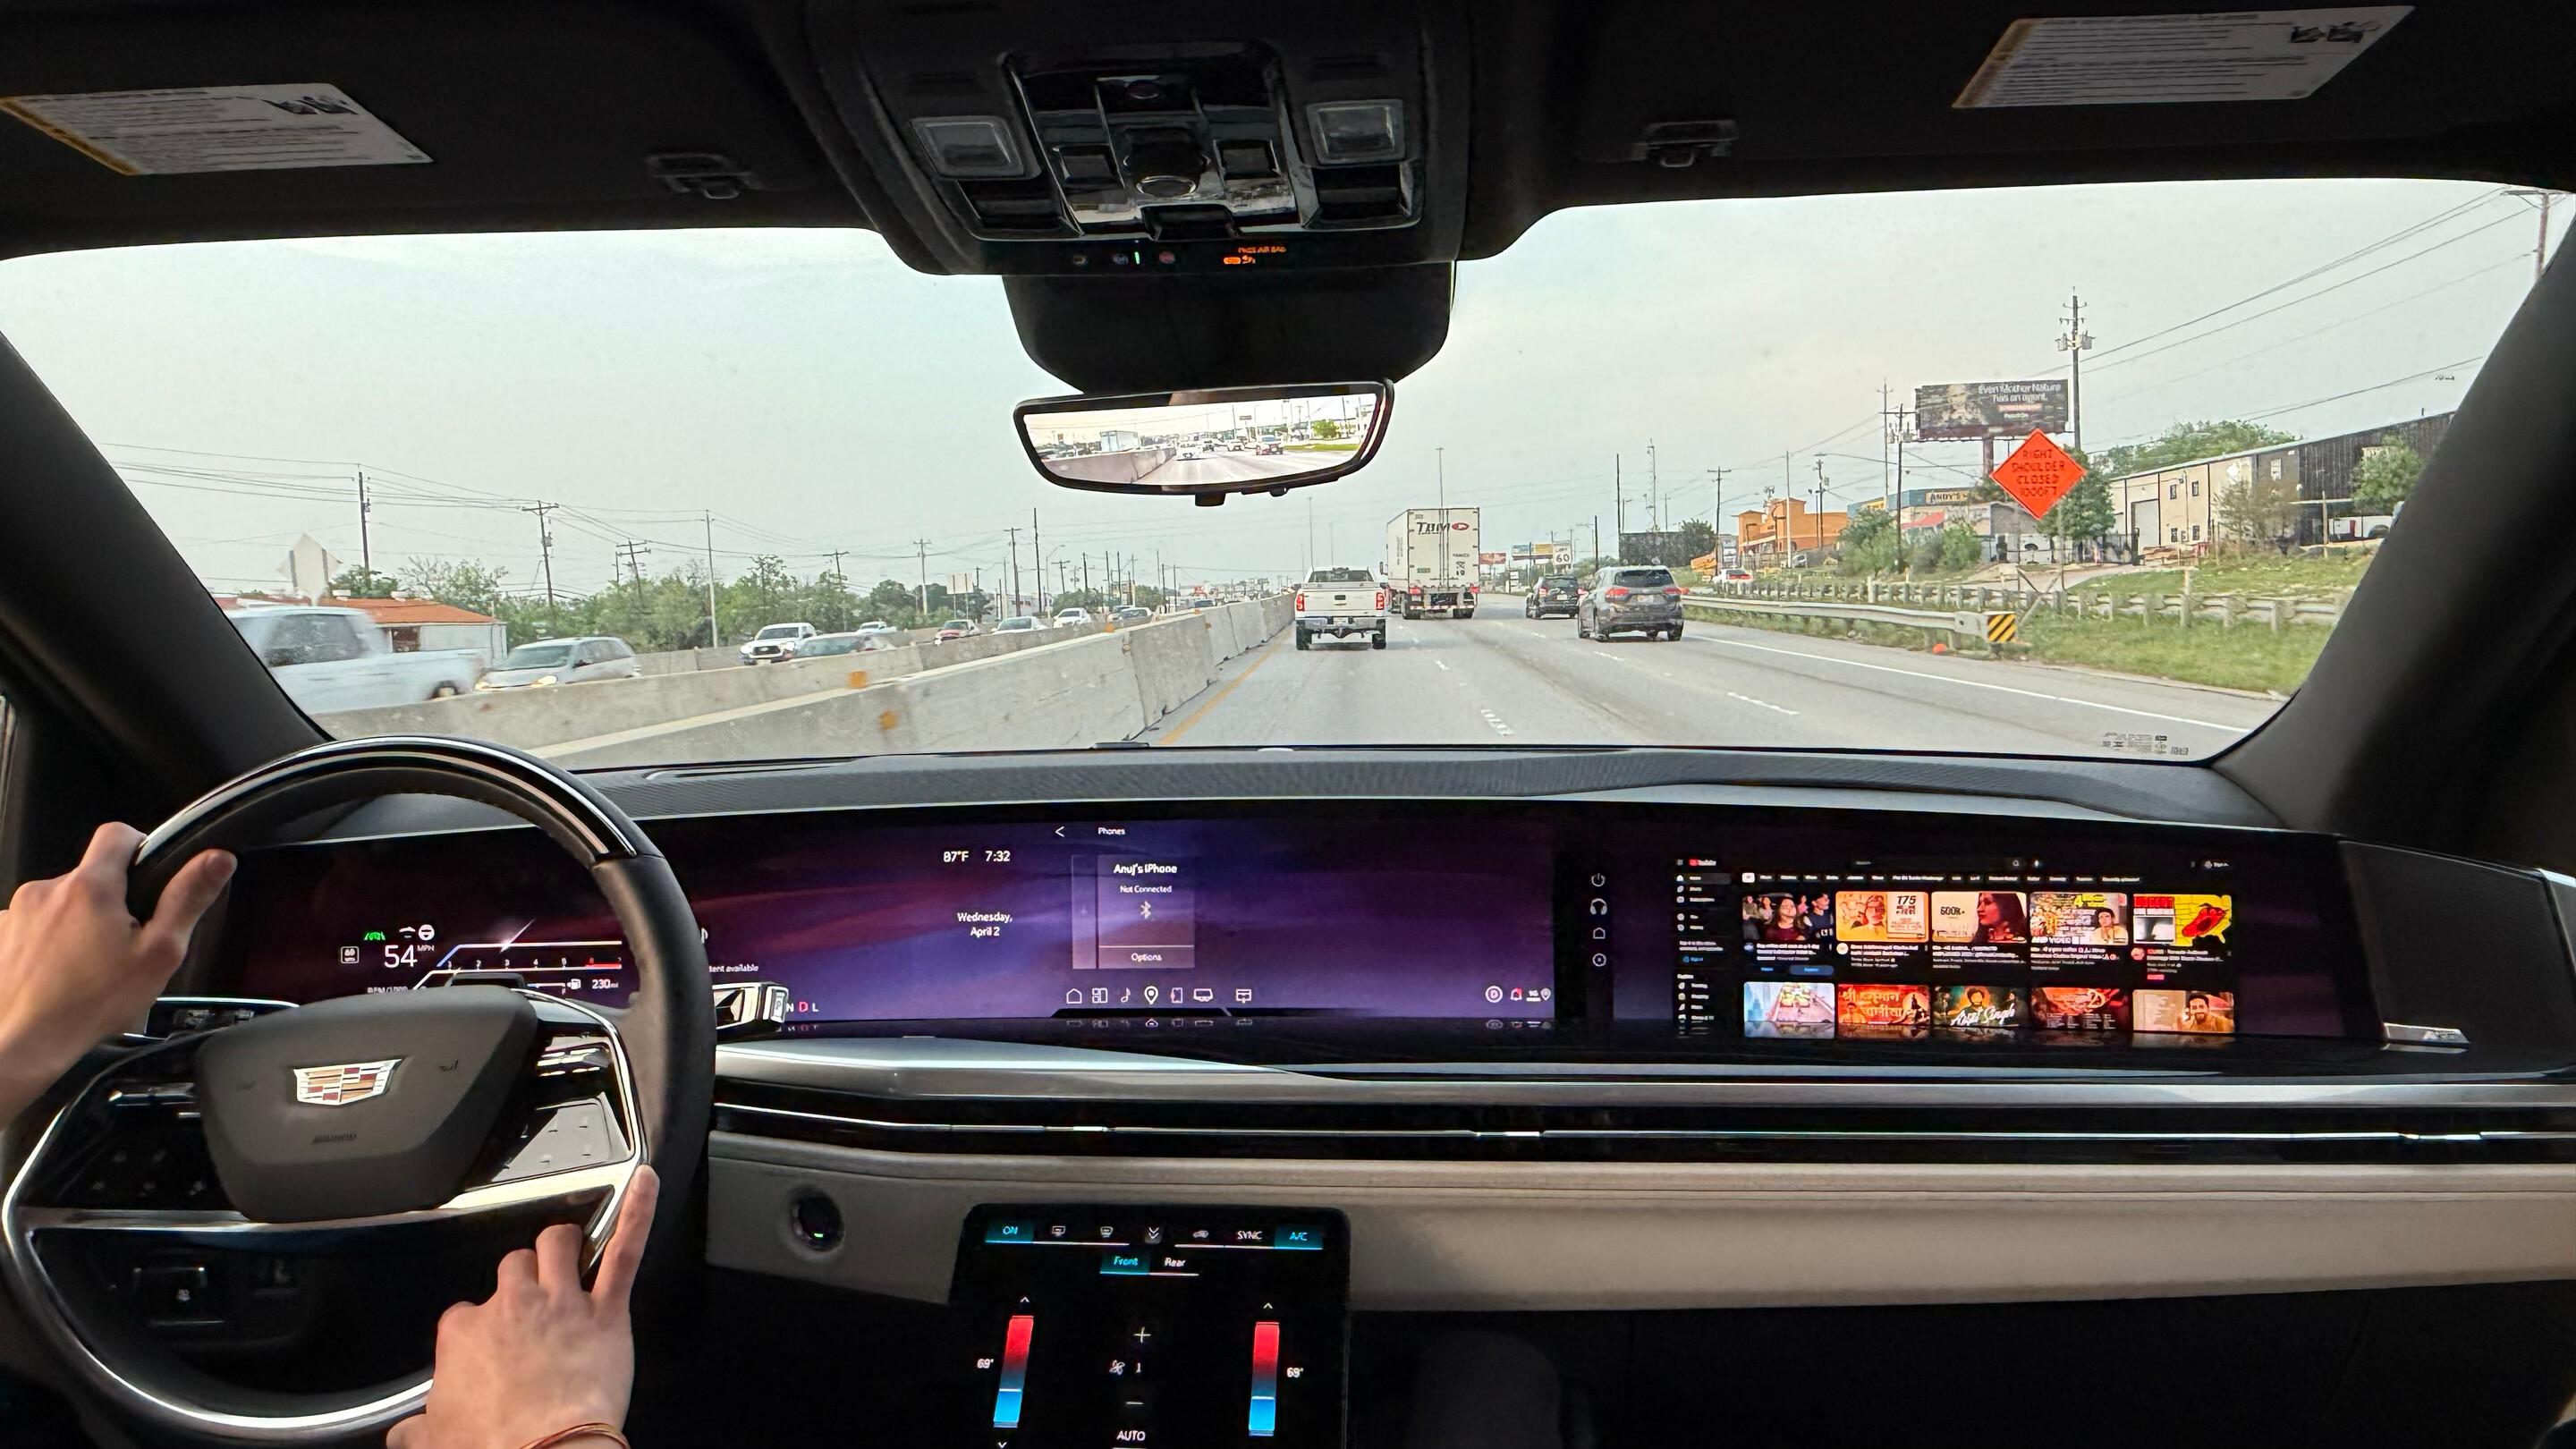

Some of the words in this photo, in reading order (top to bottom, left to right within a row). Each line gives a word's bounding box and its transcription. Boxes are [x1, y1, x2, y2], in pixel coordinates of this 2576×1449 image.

[2022, 449, 2053, 459] RIGHT
[2012, 461, 2065, 472] SHOULDER
[2016, 474, 2060, 484] CLOSED
[1556, 553, 1570, 564] 60
[1098, 826, 1125, 835] Phones
[944, 851, 969, 862] 87°F
[985, 851, 1011, 861] 7:32
[1145, 863, 1178, 874] iPhone
[1134, 885, 1172, 893] Connected
[957, 911, 1013, 923] Wednesday,
[970, 927, 993, 937] April
[994, 927, 1000, 936] 2
[384, 945, 418, 968] 54
[1131, 953, 1162, 962] Options
[799, 1002, 809, 1013] D
[812, 1003, 819, 1013] L
[1003, 1225, 1018, 1234] ON
[1237, 1230, 1263, 1240] SYNC
[1289, 1232, 1309, 1241] A/C
[1114, 1257, 1139, 1266] Front
[1165, 1258, 1186, 1267] Rear
[1116, 1430, 1146, 1441] AUTO
